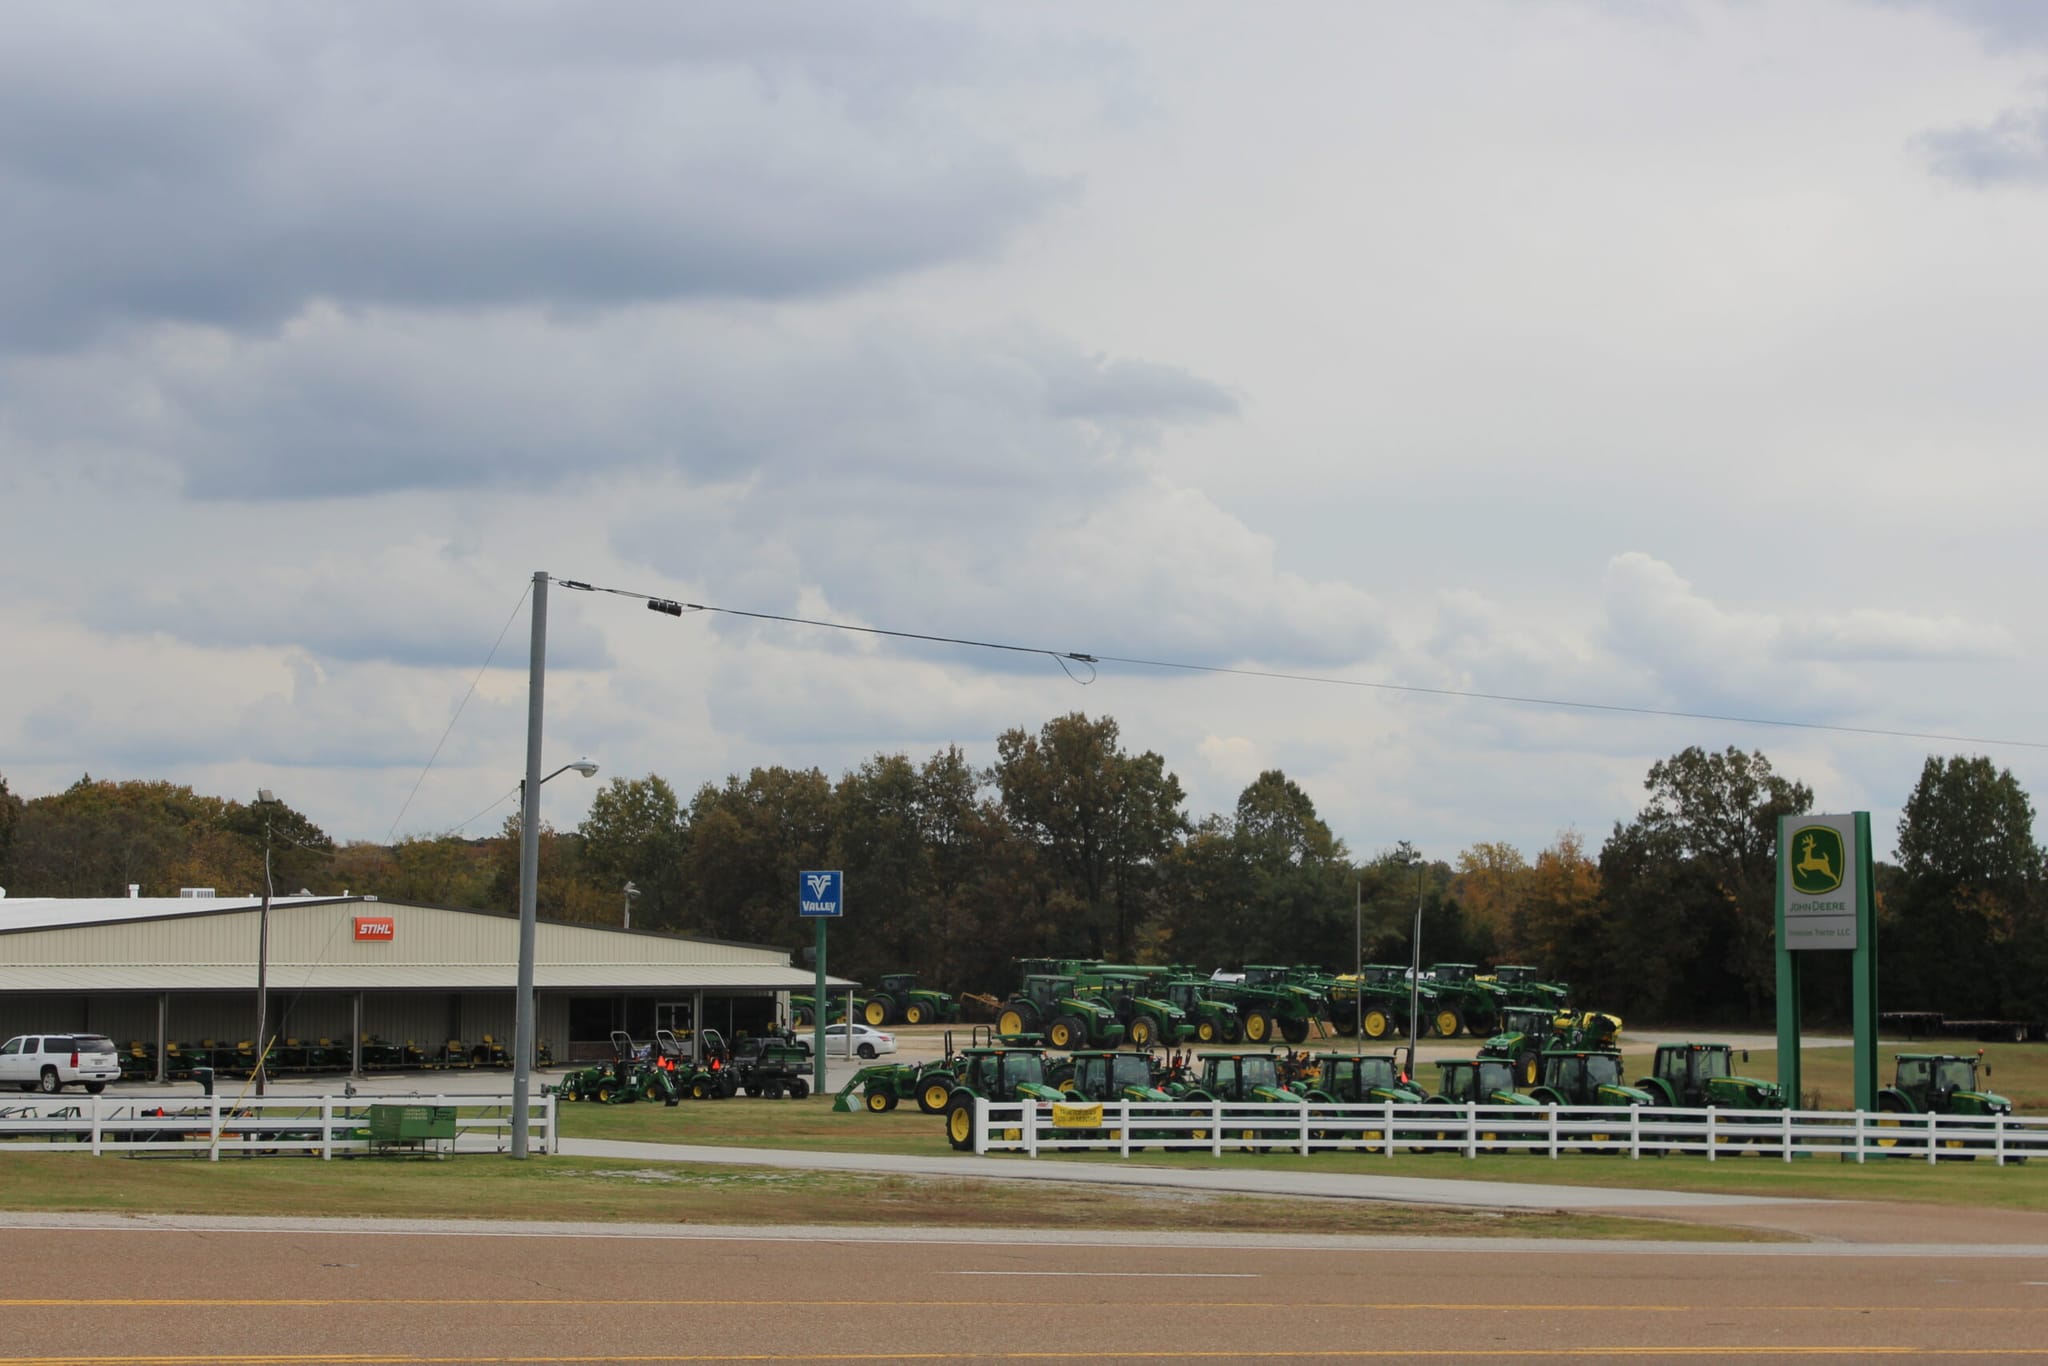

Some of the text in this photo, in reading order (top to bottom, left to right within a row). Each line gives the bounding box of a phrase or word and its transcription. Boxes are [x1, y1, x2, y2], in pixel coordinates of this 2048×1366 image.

[1790, 901, 1847, 912] JOHN DEERE
[360, 924, 391, 934] STIHL
[1837, 928, 1850, 936] LLC
